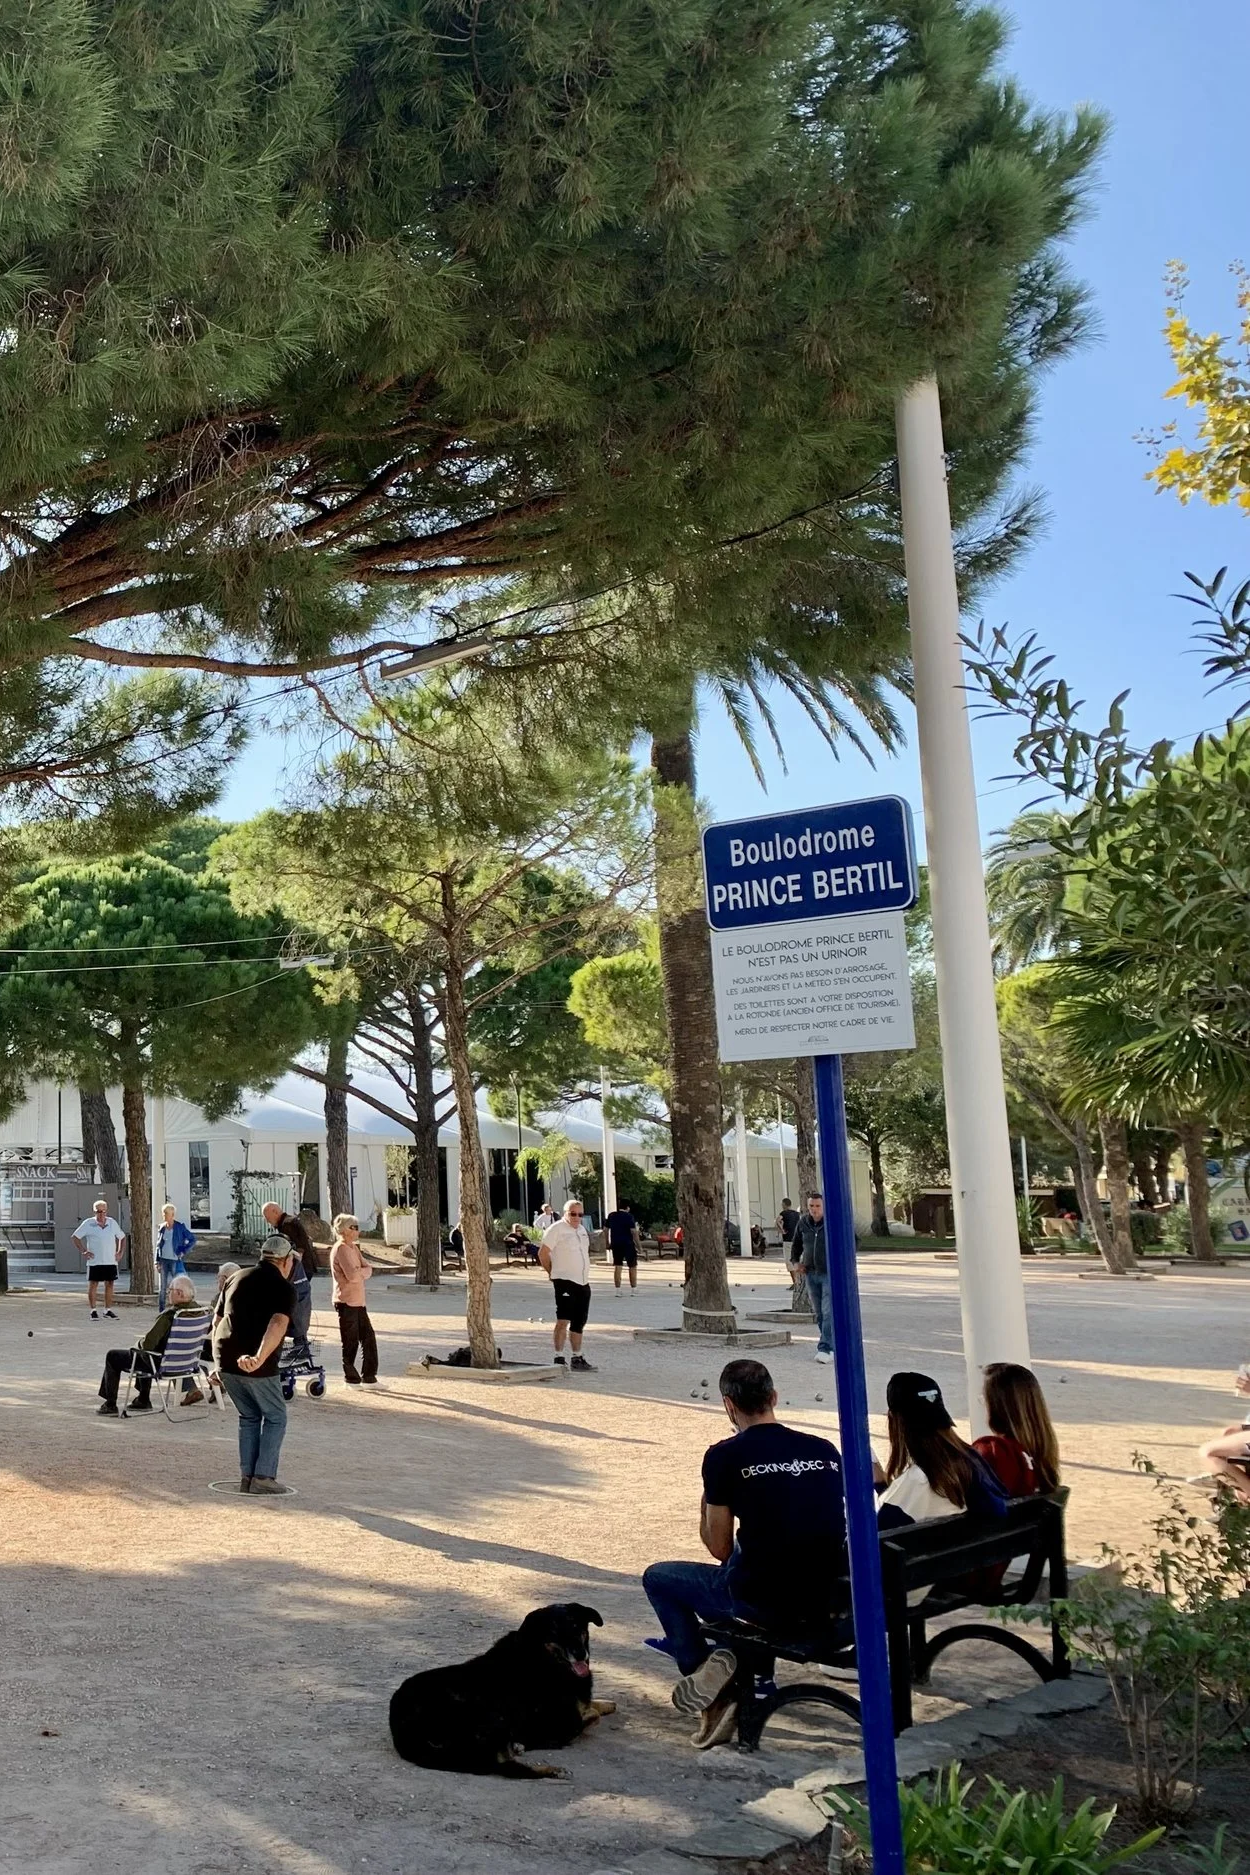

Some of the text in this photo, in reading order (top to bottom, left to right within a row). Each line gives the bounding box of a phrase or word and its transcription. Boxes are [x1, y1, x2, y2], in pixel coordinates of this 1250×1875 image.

[730, 825, 875, 867] Boulodrome
[713, 861, 903, 913] PRINCE BERTIL
[722, 929, 894, 957] LE BOULODROME PRINCE BERTIL
[748, 946, 867, 968] N'EST PAS UN URINOIR
[756, 973, 789, 982] N'AVONS
[791, 971, 804, 979] PAS
[806, 968, 833, 978] BESOIN
[726, 988, 738, 996] LES
[741, 983, 780, 995] JARDINIERS
[782, 982, 790, 990] ET
[793, 980, 803, 989] LA
[834, 976, 851, 985] S'EN
[750, 998, 786, 1009] TOILETTES
[787, 996, 807, 1006] SONT
[818, 994, 843, 1003] VOTRE
[845, 989, 894, 1001] DISPOSITION
[746, 1009, 781, 1019] ROTONDE
[783, 1006, 814, 1017] (ANCIEN
[816, 1003, 843, 1013] OFFICE
[845, 1002, 855, 1011] DE
[735, 1027, 758, 1036] MERCI
[759, 1026, 768, 1034] DE
[770, 1023, 810, 1034] RESPECTER
[812, 1020, 838, 1029] NOTRE
[840, 1018, 866, 1028] CADRE
[868, 1016, 878, 1025] DE
[16, 1166, 56, 1179] SNACK
